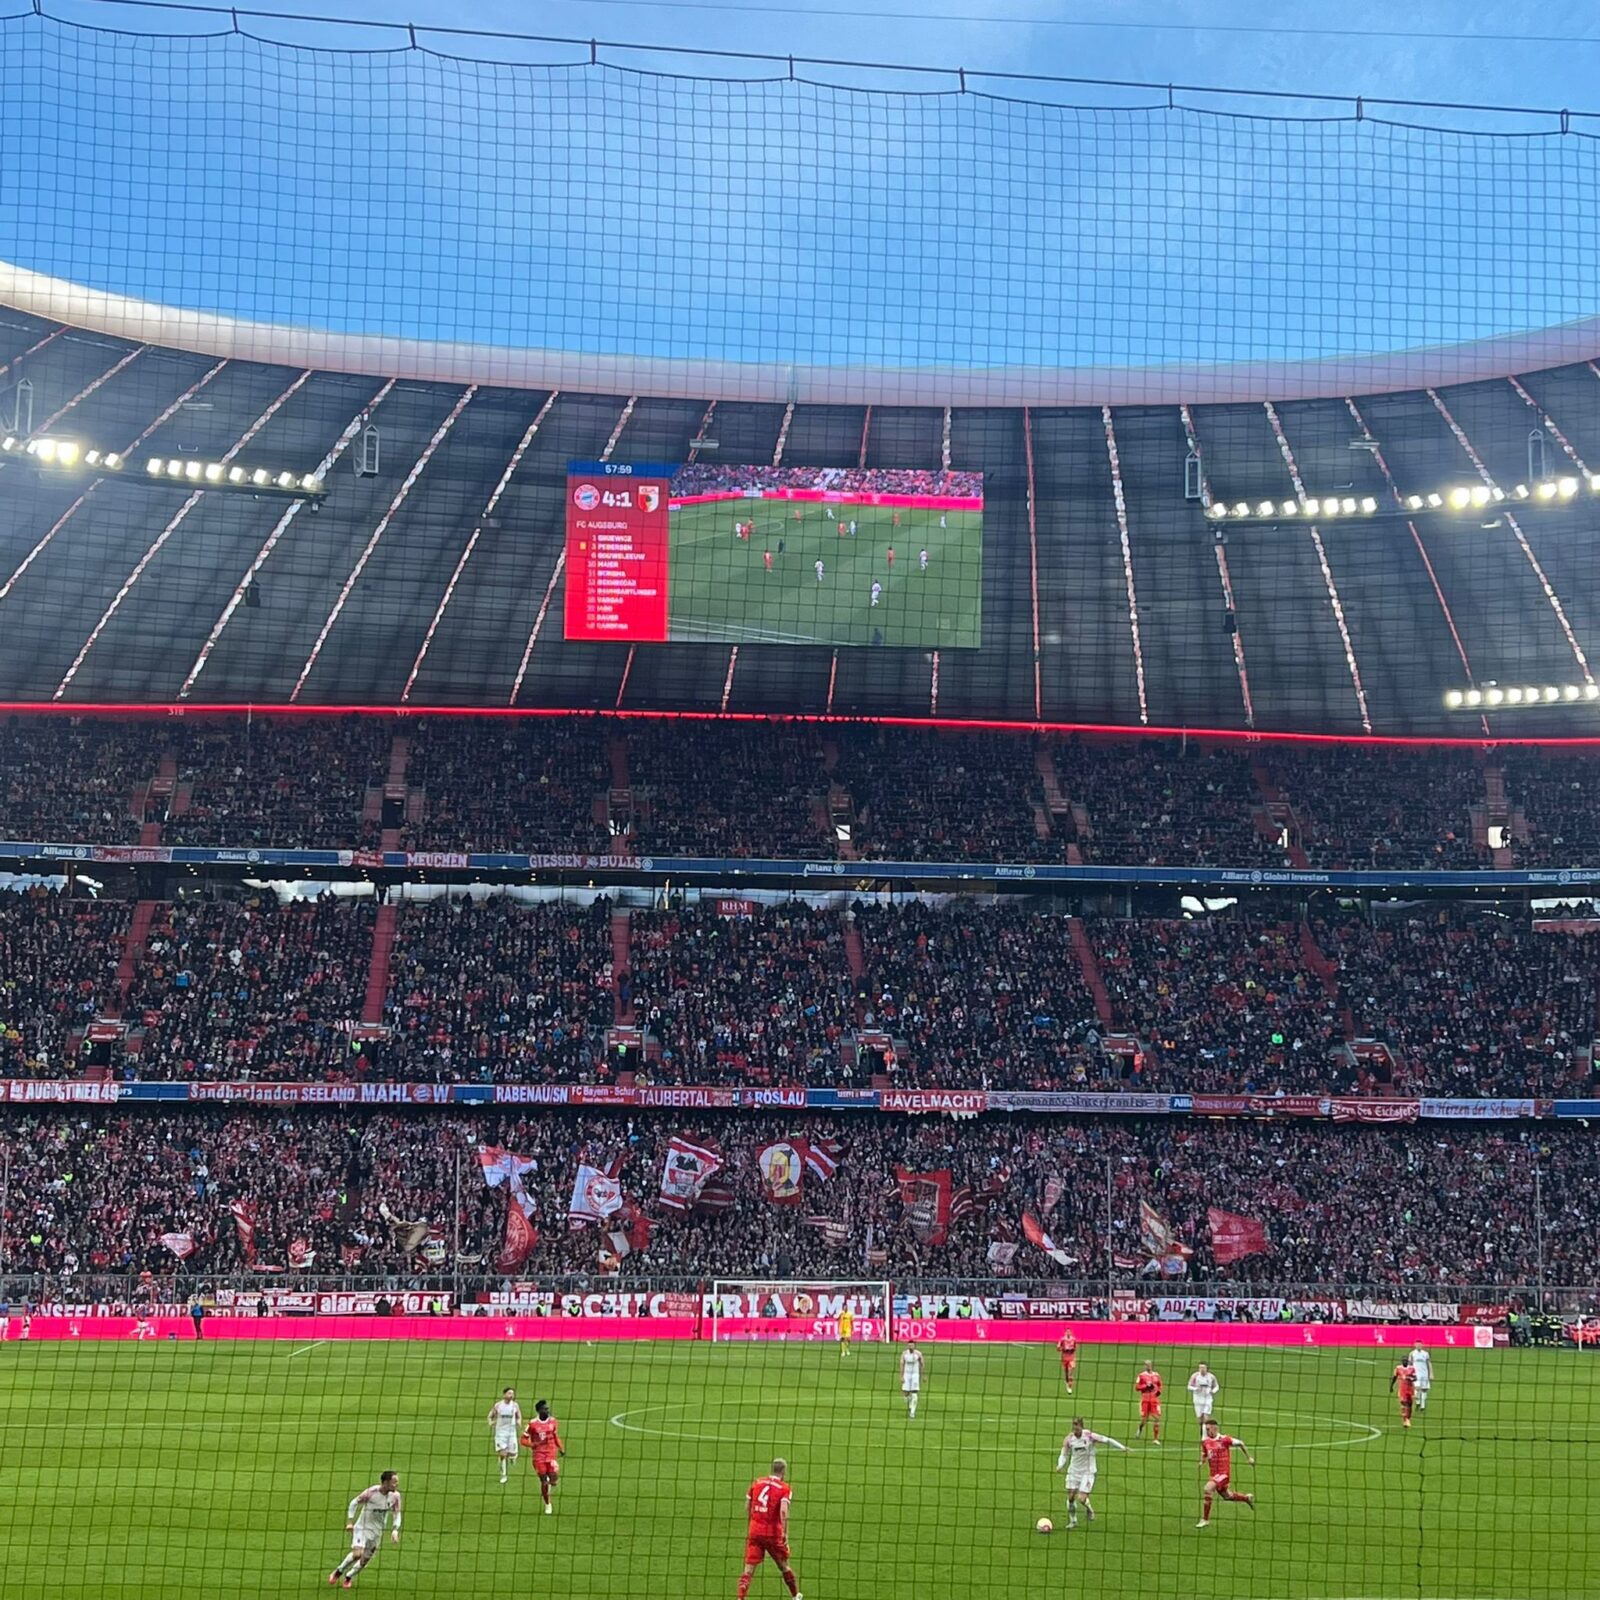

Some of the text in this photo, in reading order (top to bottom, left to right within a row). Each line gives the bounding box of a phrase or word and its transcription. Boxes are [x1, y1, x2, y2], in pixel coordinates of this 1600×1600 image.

[605, 465, 632, 474] 57:59
[602, 490, 632, 507] 4:1
[576, 521, 628, 530] FC AUGSBURG
[42, 846, 74, 856] Allianz
[216, 851, 246, 861] Allianz
[529, 854, 642, 869] GIESSEN BULLS
[804, 863, 832, 873] Allianz
[994, 867, 1023, 877] Allianz
[1221, 871, 1330, 882] Allianz Global Investors
[1527, 872, 1558, 881] Allianz
[301, 1086, 355, 1101] SEELAND
[571, 1086, 582, 1096] FC
[583, 1087, 609, 1098] Bayern
[638, 1089, 711, 1106] TAUBERTAL
[754, 1088, 805, 1106] RÖSLAU
[883, 1093, 984, 1109] HAVELMACHT
[757, 1485, 771, 1508] 4
